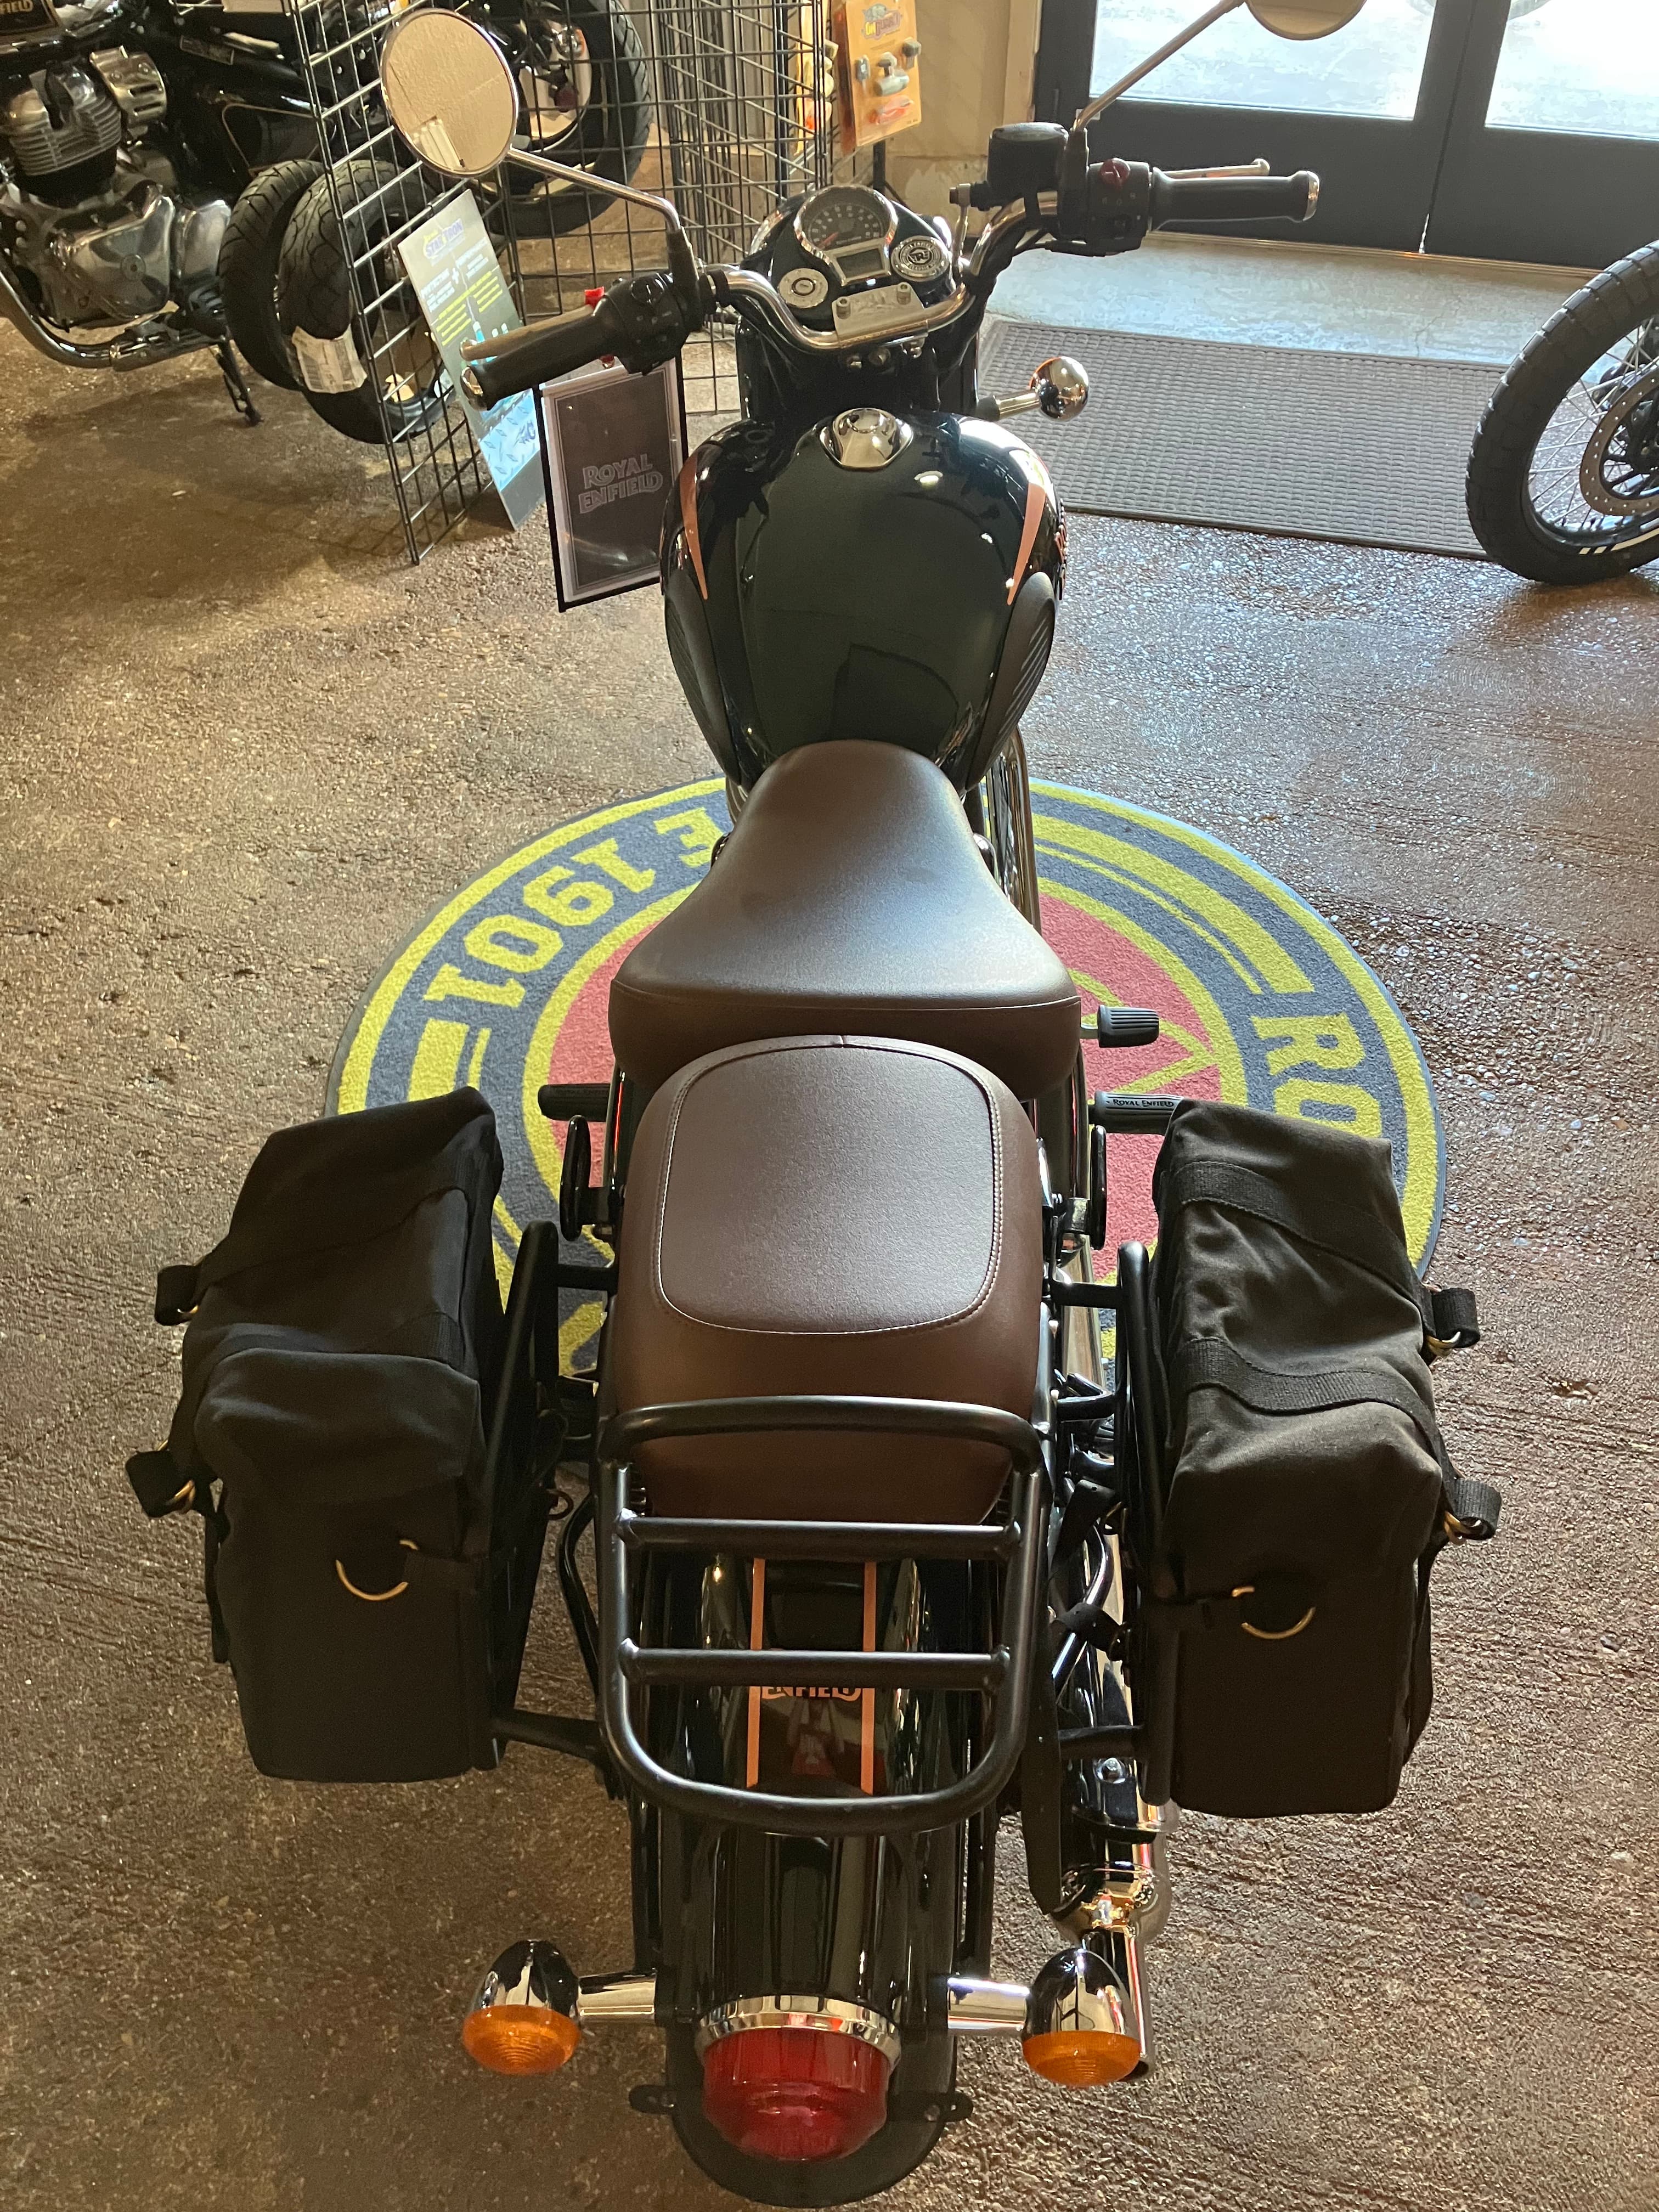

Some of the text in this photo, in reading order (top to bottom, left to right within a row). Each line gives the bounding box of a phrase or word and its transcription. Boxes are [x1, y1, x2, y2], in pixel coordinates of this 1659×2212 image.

[578, 471, 663, 514] ENFIELD
[583, 454, 653, 489] ROYAL
[424, 838, 656, 1008] 1901
